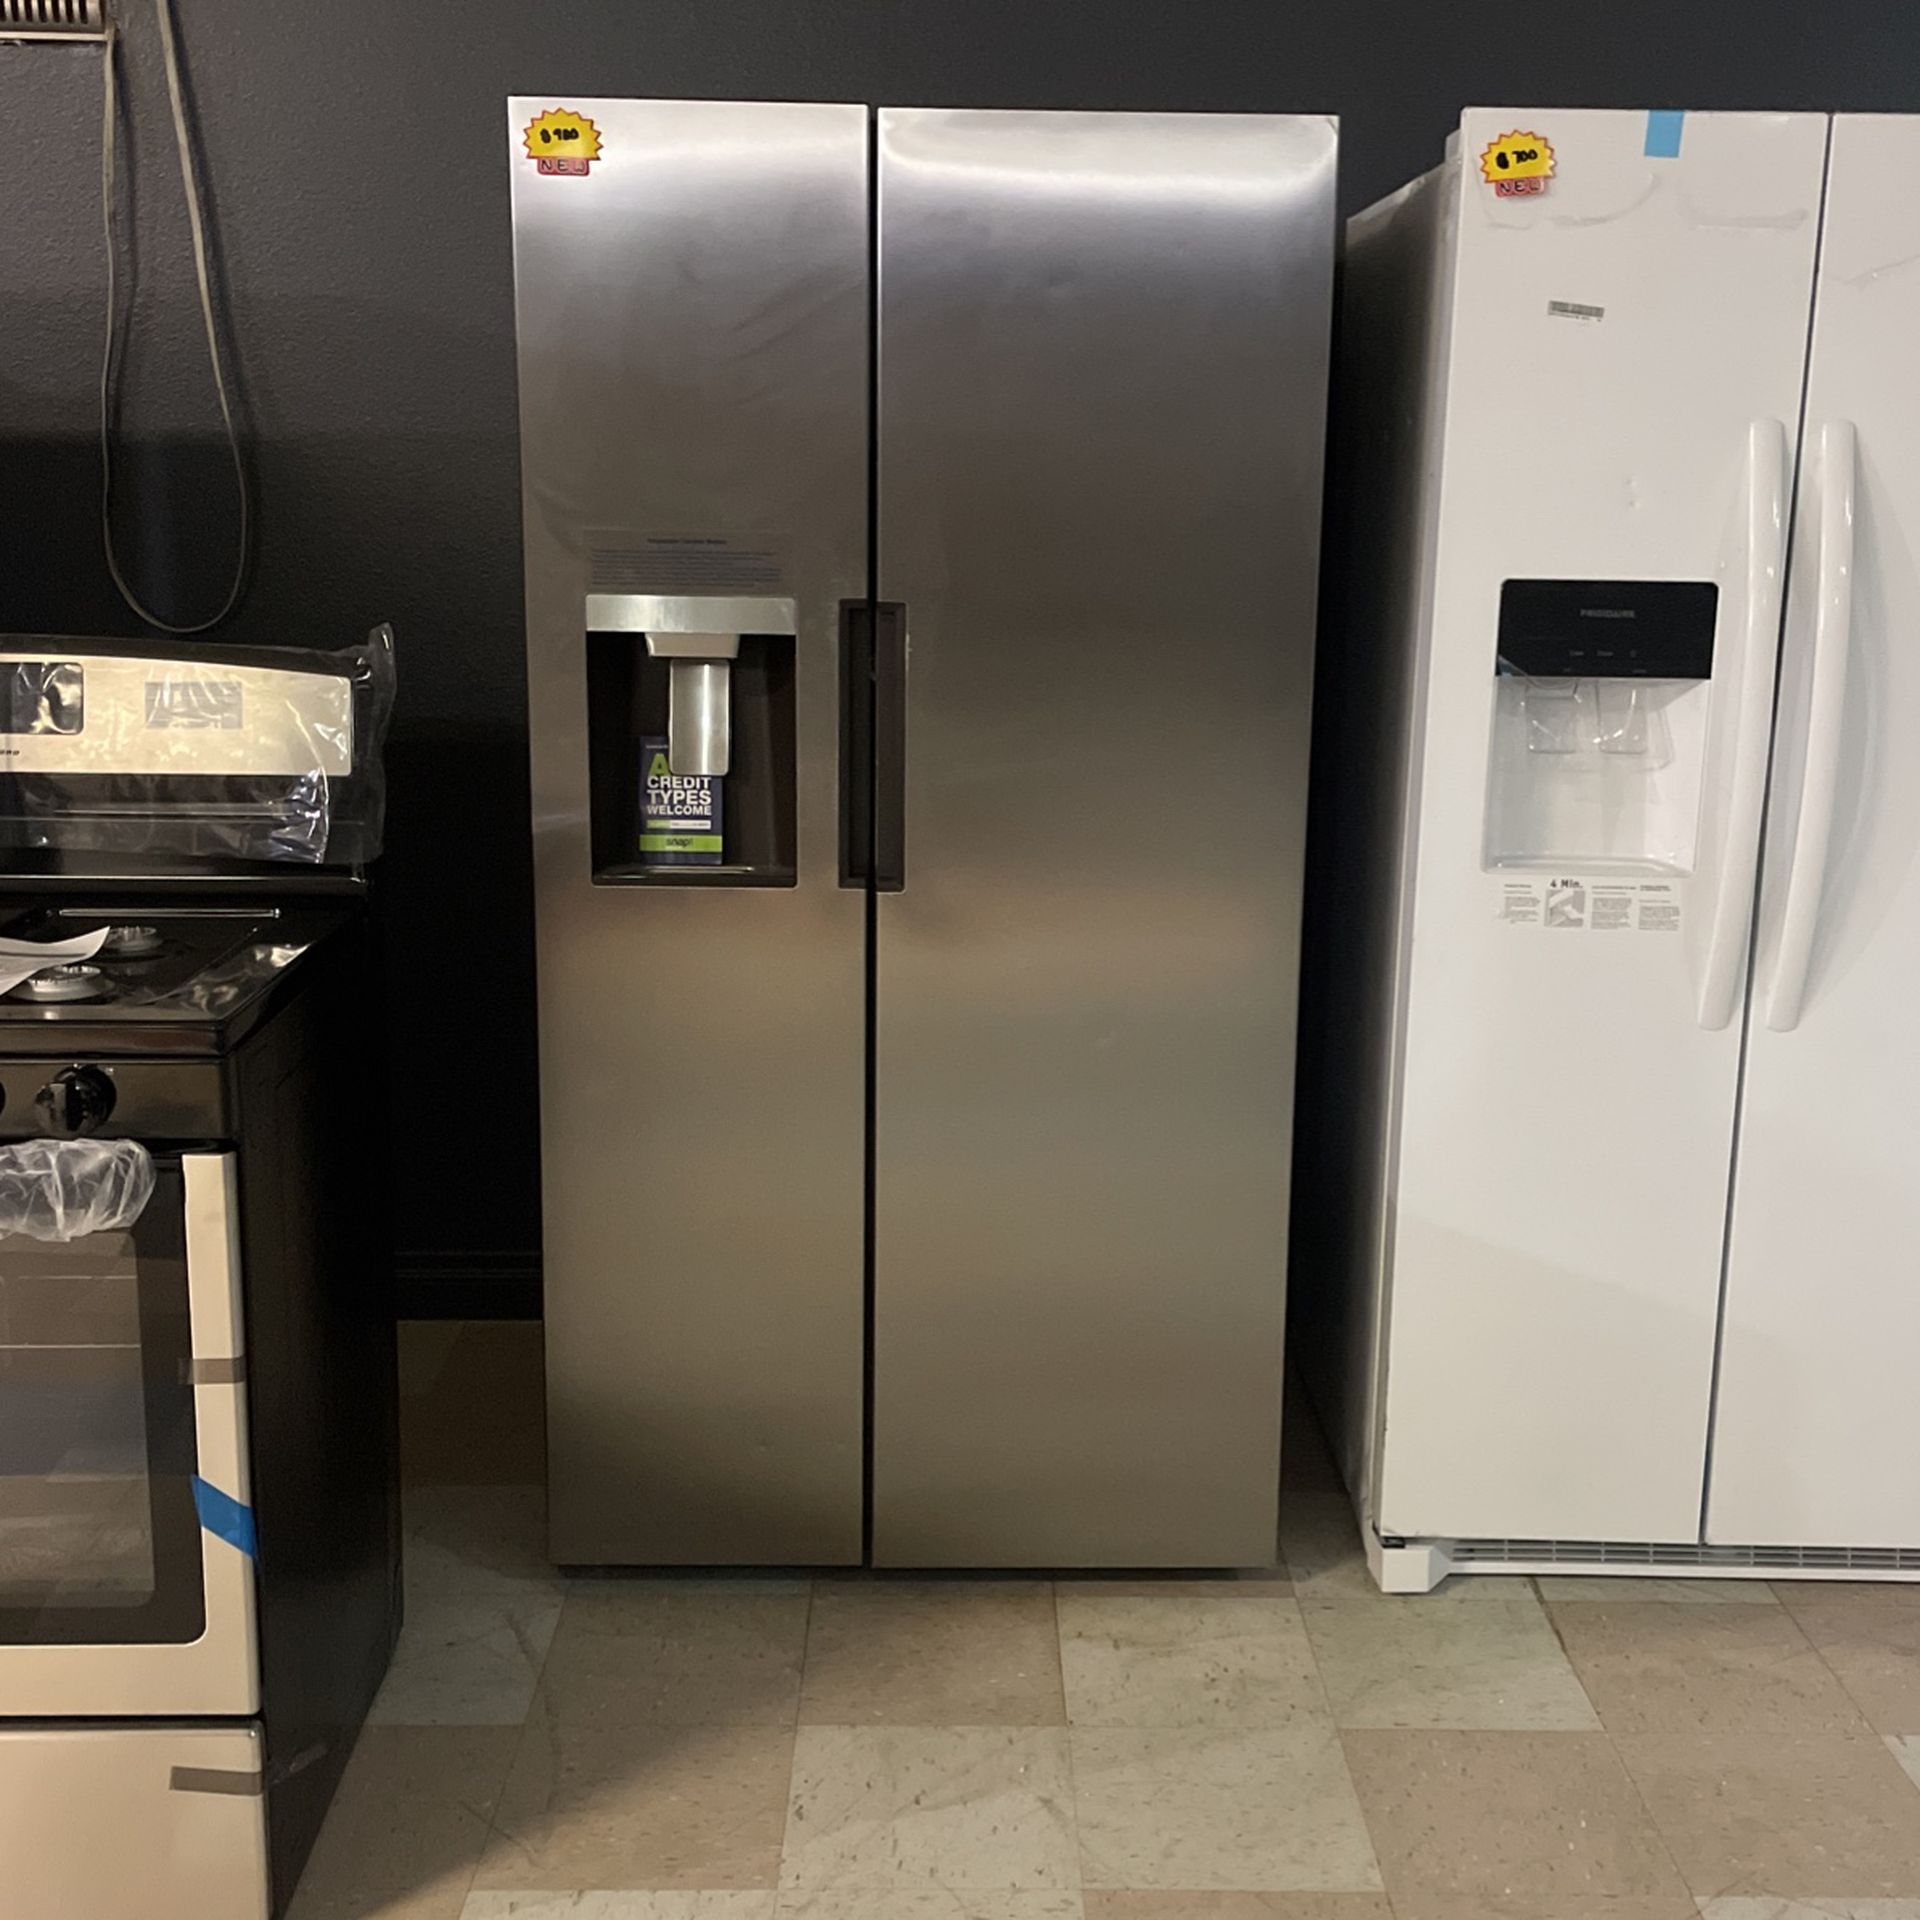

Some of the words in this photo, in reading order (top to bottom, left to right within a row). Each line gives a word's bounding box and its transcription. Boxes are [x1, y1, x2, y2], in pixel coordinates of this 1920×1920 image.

[647, 776, 712, 789] CREDIT
[646, 790, 712, 805] TYPES
[646, 805, 712, 816] WELCOME
[1550, 880, 1557, 888] 4
